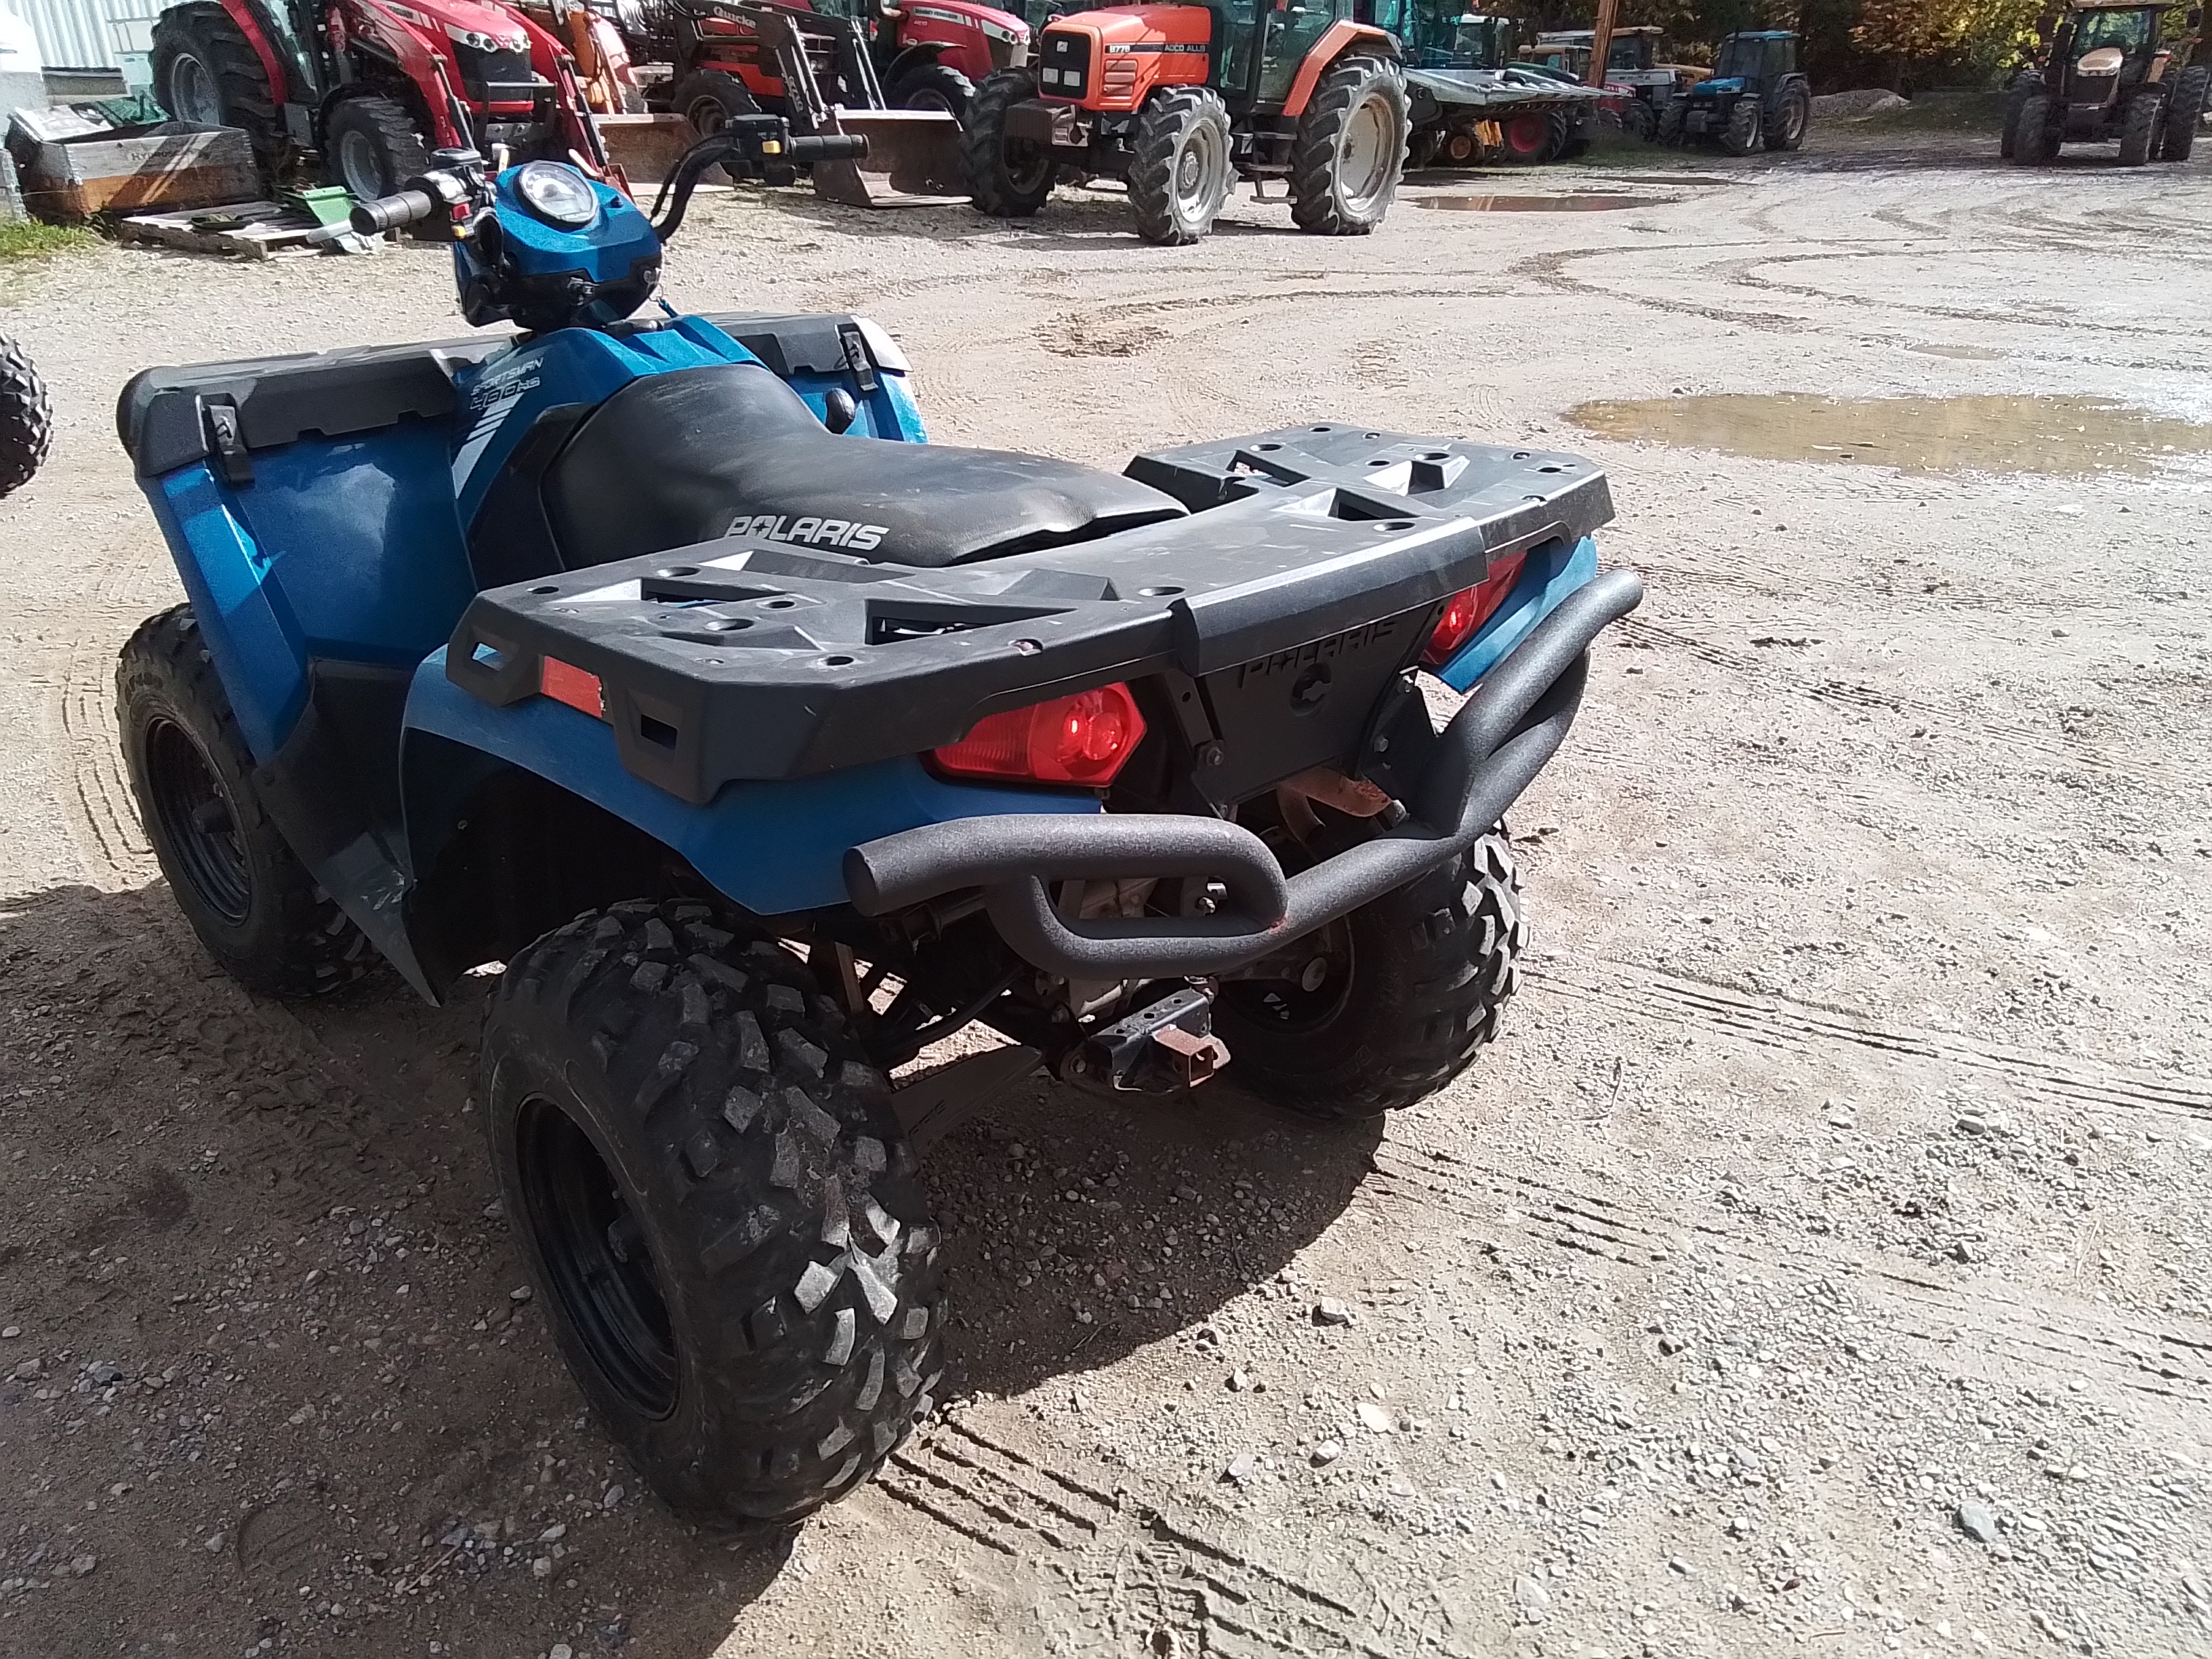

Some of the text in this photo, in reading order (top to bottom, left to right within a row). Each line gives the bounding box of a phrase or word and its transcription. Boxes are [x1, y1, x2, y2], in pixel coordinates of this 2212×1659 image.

[713, 5, 756, 28] Quicke
[470, 356, 544, 396] SPORTSMAN
[724, 515, 890, 551] POLARIS
[1237, 620, 1397, 690] POLARIS
